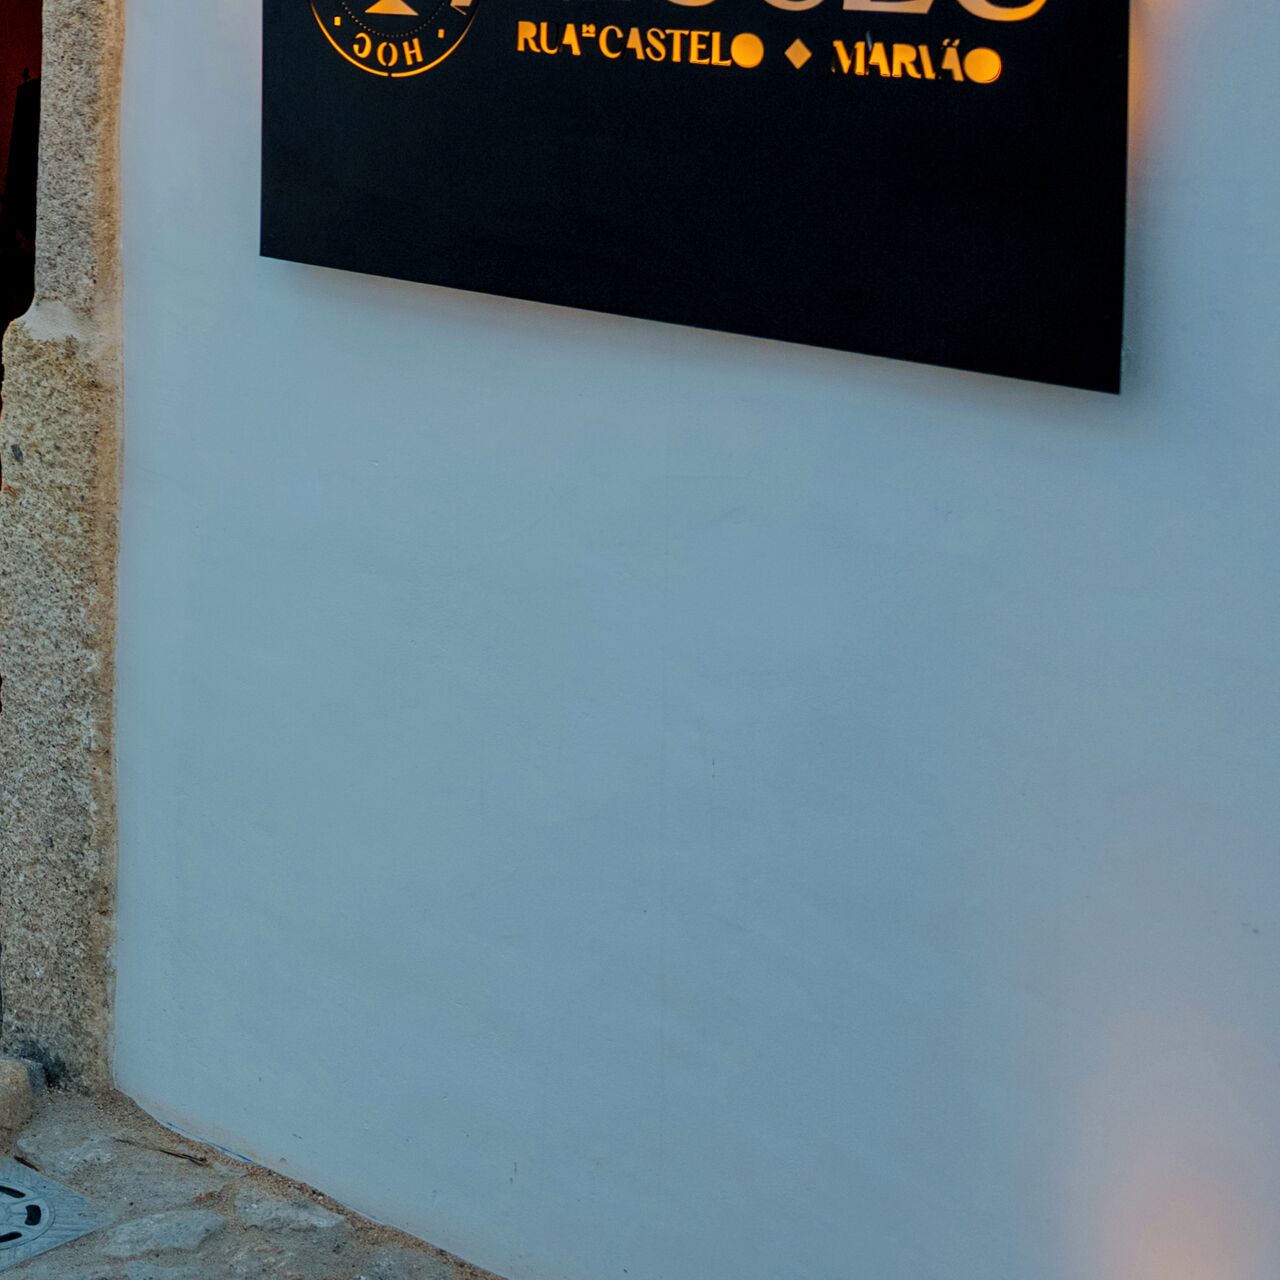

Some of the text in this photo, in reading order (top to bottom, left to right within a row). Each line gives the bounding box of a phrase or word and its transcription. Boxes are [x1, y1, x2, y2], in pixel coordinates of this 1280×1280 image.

[352, 32, 424, 67] HOC
[517, 21, 581, 56] RUA
[598, 25, 764, 69] CASTELO
